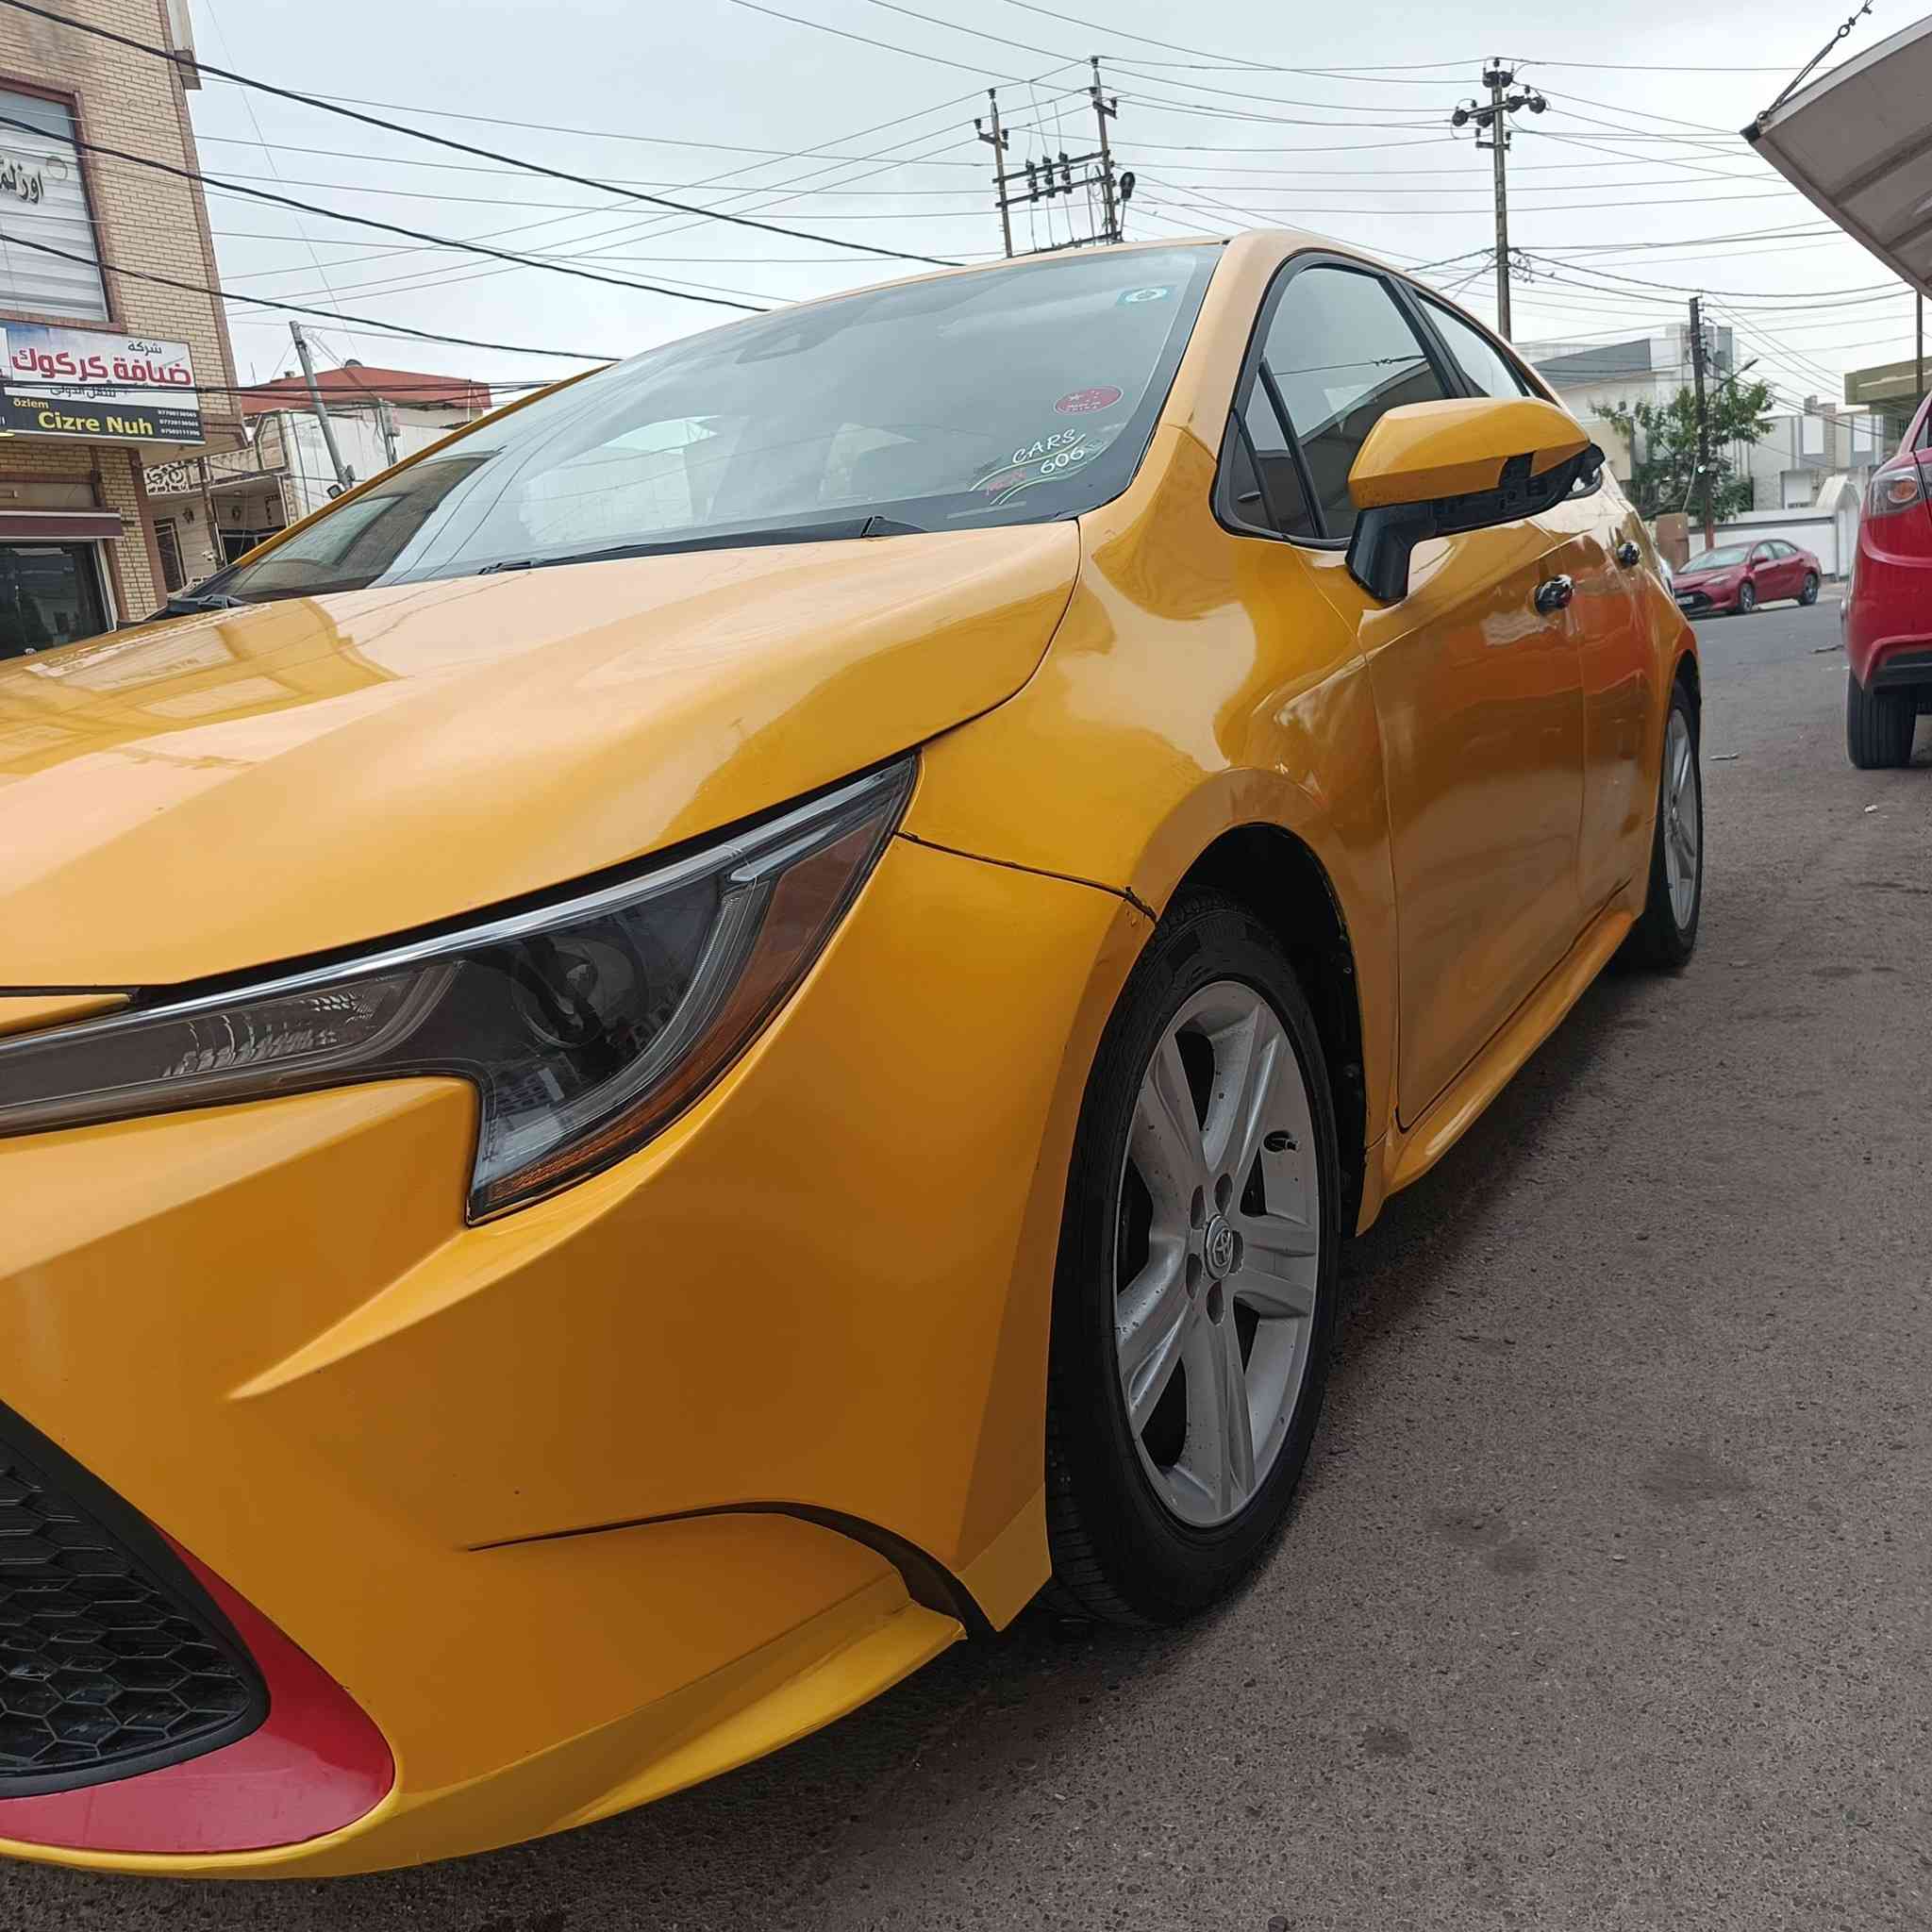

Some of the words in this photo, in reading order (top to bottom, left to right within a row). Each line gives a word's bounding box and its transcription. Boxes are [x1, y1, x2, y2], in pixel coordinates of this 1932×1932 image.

[127, 340, 162, 357] شركة
[12, 347, 108, 381] كركوك
[38, 411, 100, 431] Cizre
[108, 418, 153, 435] Nuh
[1012, 428, 1075, 463] CARS
[1040, 446, 1084, 475] 606
